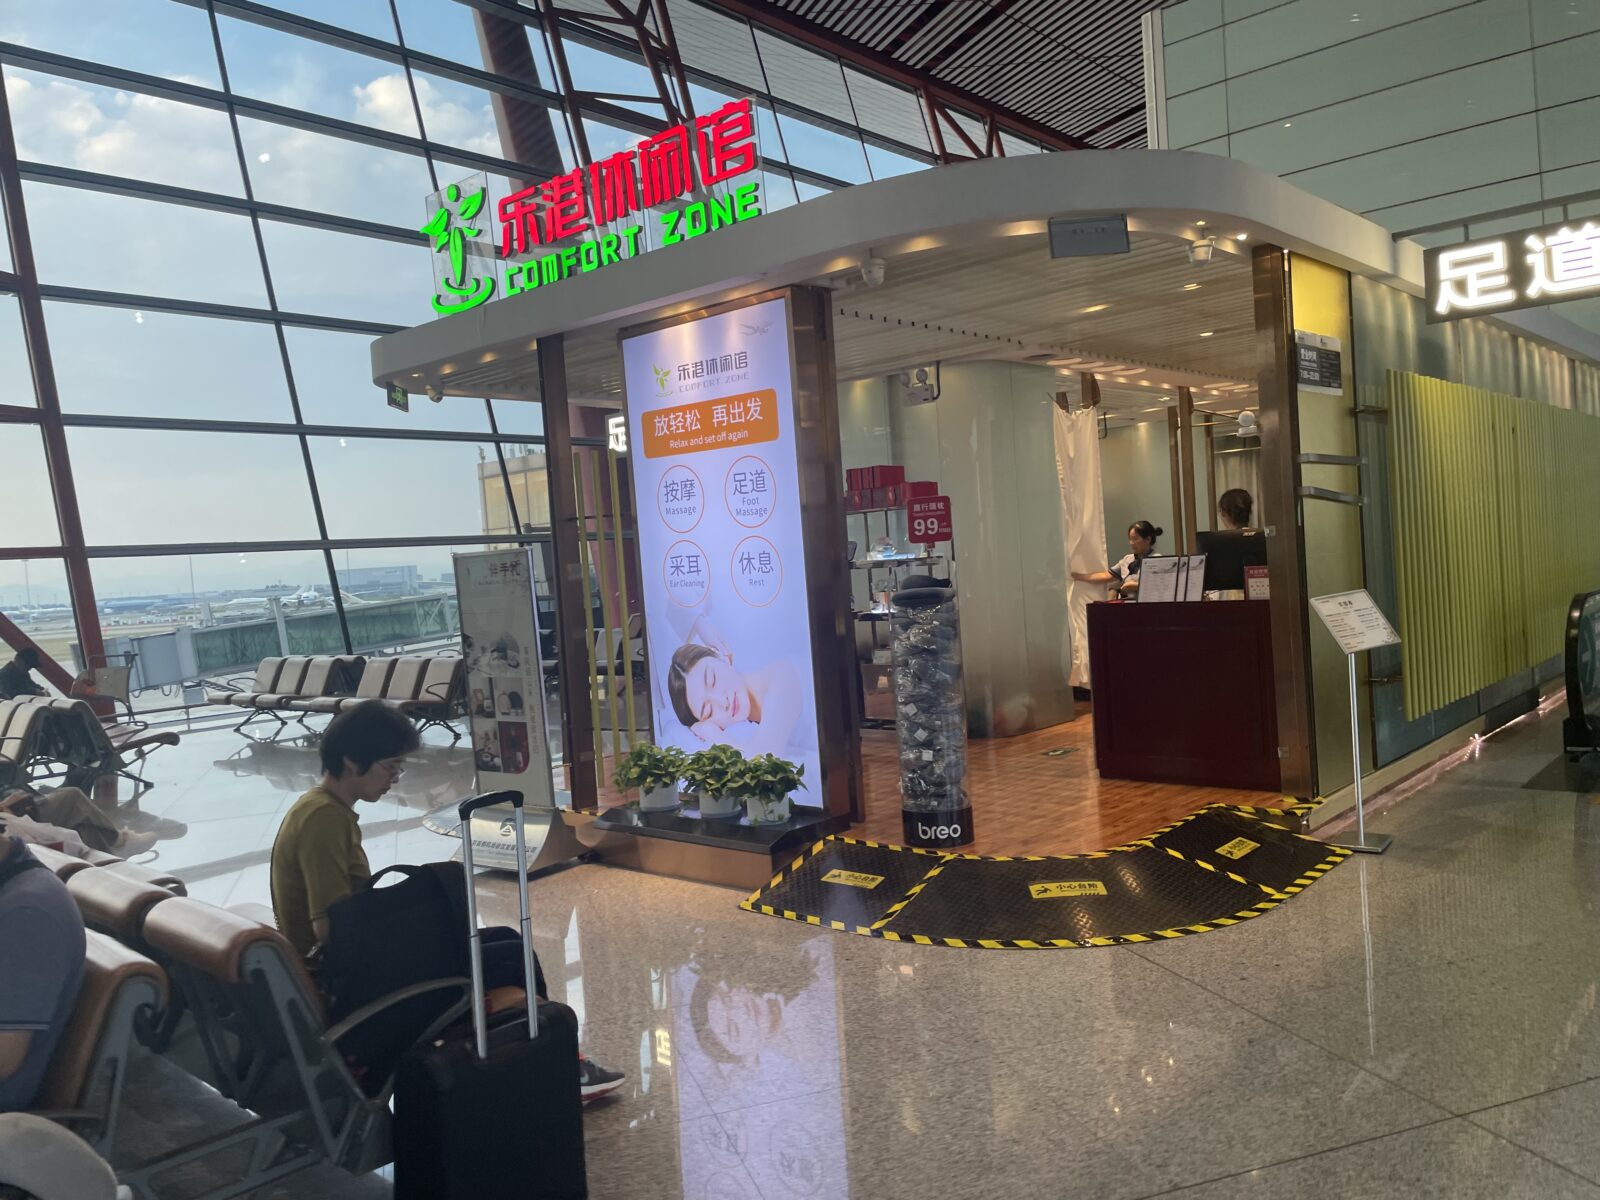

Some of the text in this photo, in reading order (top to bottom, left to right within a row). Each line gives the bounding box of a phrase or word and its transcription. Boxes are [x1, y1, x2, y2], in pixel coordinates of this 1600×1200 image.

[497, 97, 757, 259] 乐港休闲馆
[504, 182, 761, 297] COMFORT ZONE
[1435, 222, 1600, 315] 足道
[677, 351, 749, 382] 乐港休闲馆
[679, 371, 750, 393] COMFORT ZONE
[653, 397, 764, 438] 放轻松 再出发
[669, 429, 749, 449] Relax and set off again
[663, 478, 696, 503] 按摩
[733, 469, 768, 496] 足道
[665, 505, 697, 516] Massage
[736, 506, 768, 517] Massage
[742, 496, 760, 506] Foot
[913, 518, 939, 536] 99
[669, 554, 702, 577] 采耳
[738, 550, 774, 576] 休息
[669, 579, 705, 589] Ear Cleaning
[748, 578, 765, 587] Rest
[918, 821, 961, 840] breo
